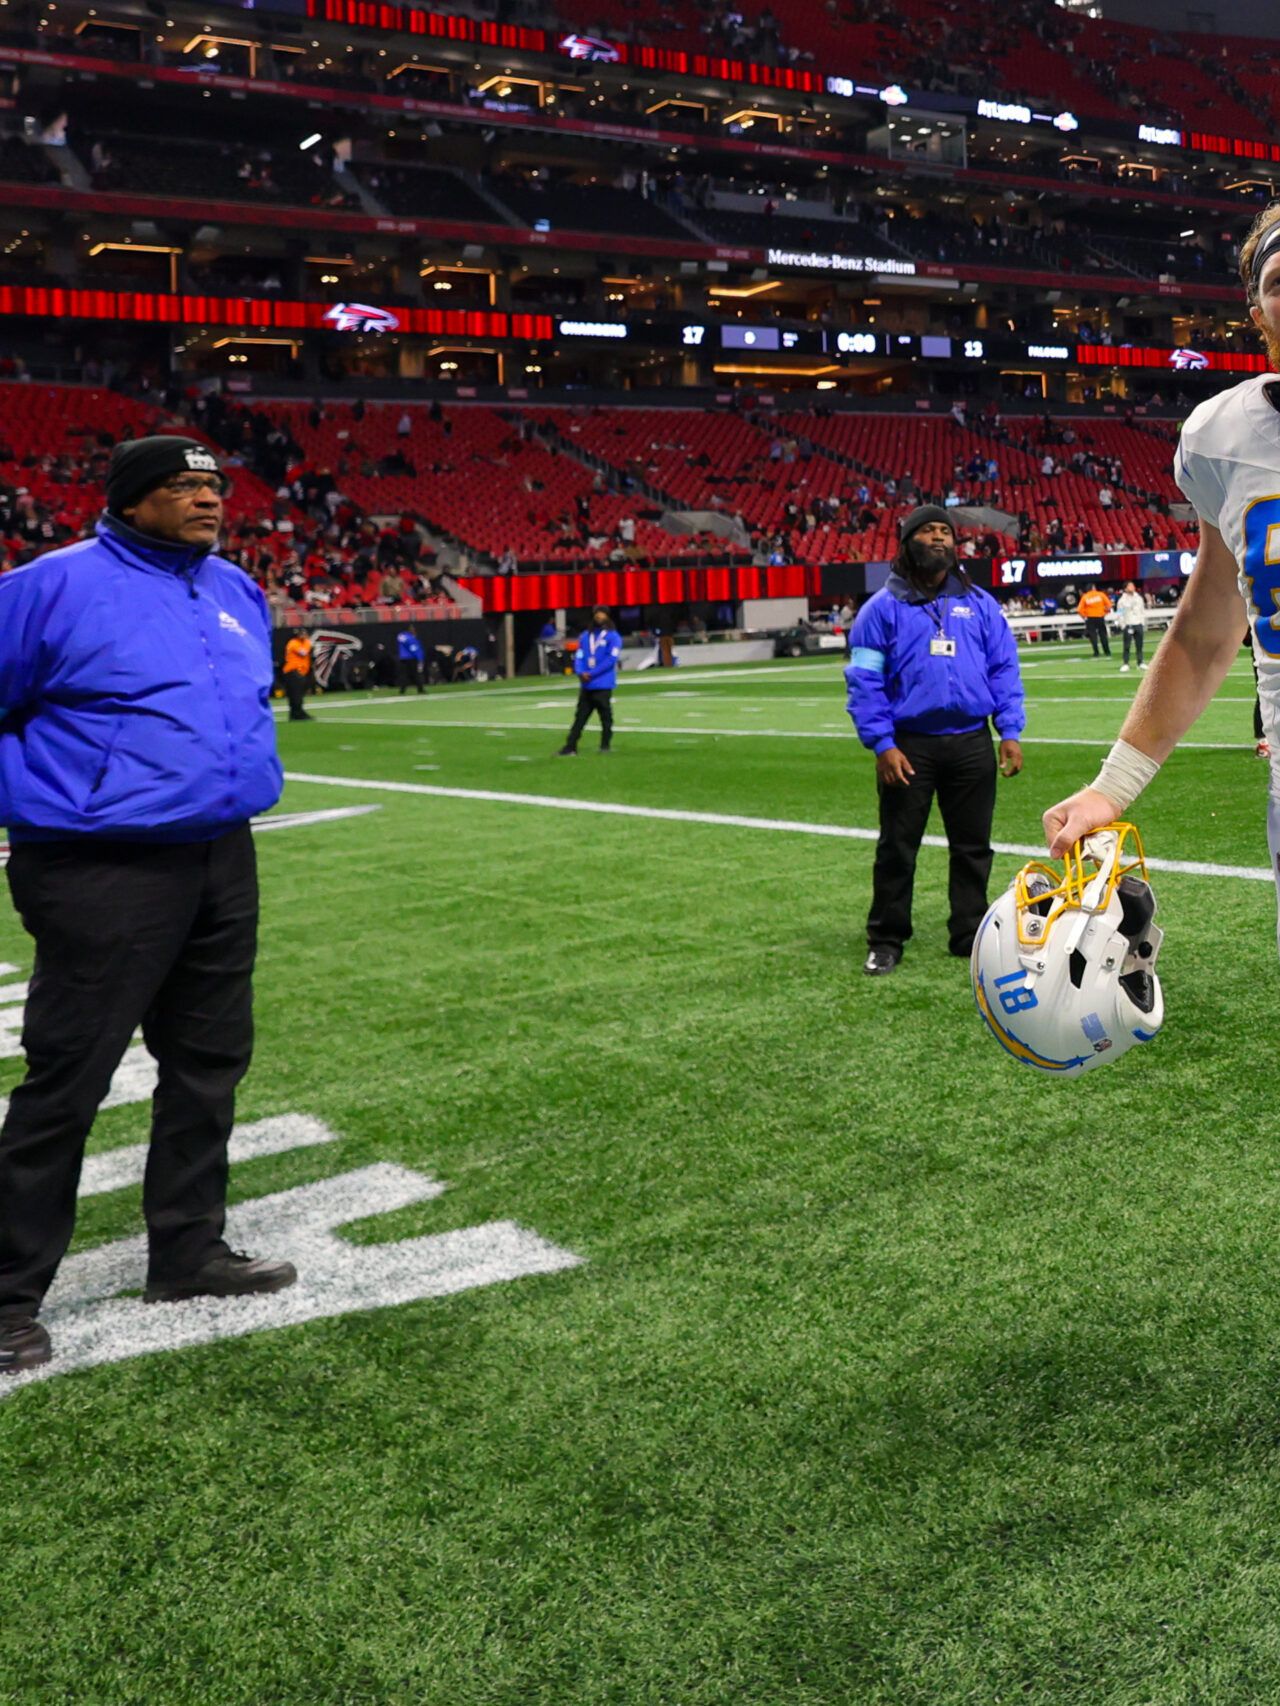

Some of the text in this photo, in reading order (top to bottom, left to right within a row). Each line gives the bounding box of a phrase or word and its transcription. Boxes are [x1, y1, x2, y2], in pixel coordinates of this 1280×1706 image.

[768, 248, 863, 271] Mercedes-Benz
[864, 257, 916, 275] Stadium
[683, 326, 705, 345] 17
[837, 332, 876, 353] 0:00
[1001, 560, 1026, 584] 17
[1037, 559, 1103, 578] CHARGERS
